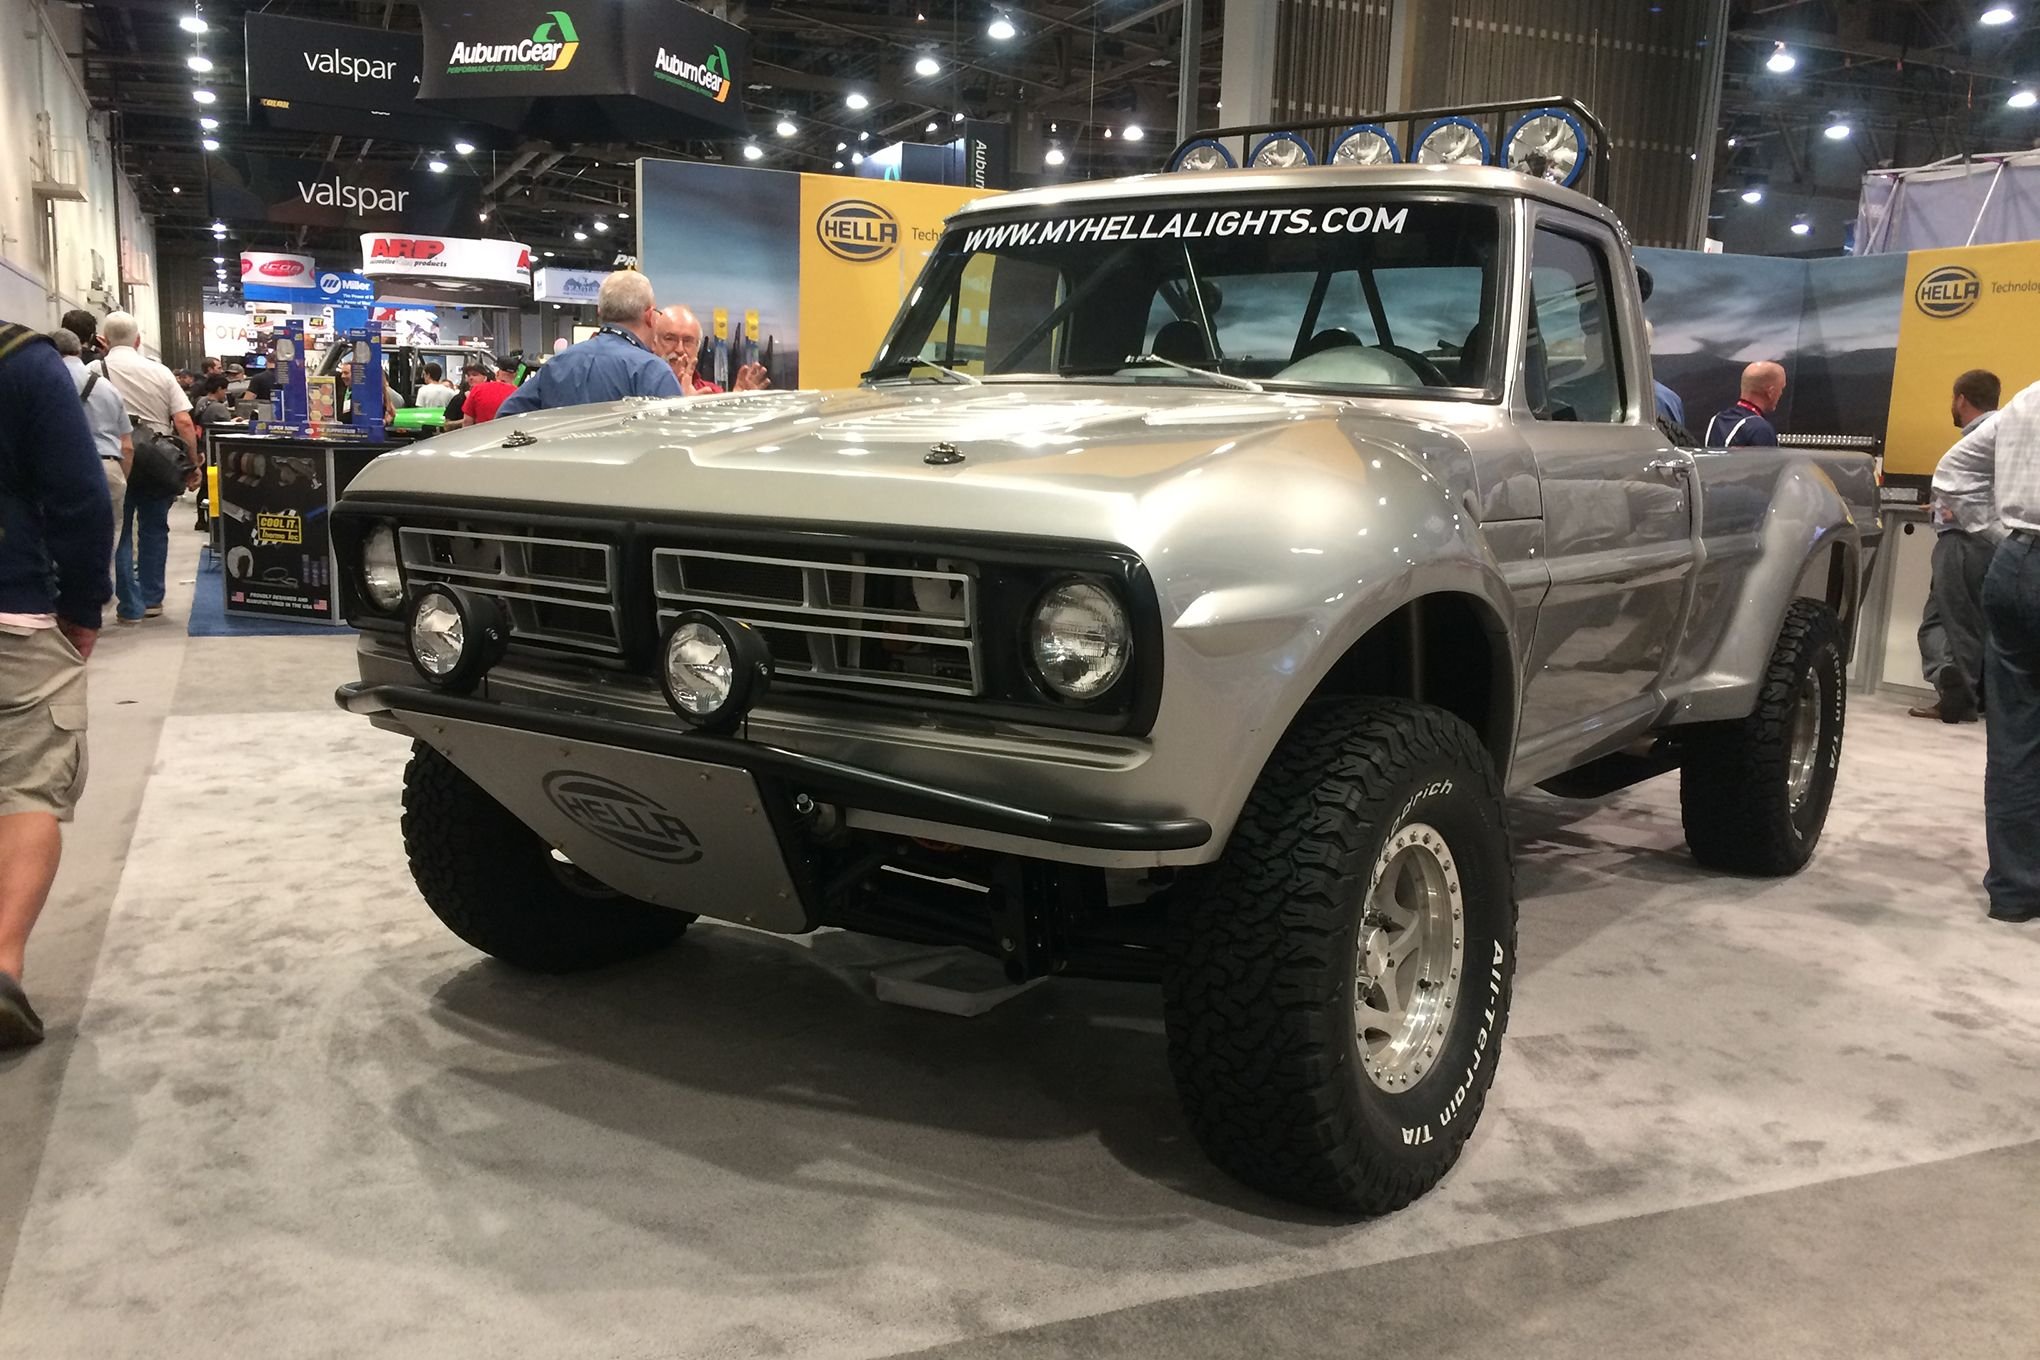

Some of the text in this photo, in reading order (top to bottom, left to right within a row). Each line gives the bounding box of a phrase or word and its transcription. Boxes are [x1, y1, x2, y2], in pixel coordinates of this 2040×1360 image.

[449, 39, 563, 65] AuburnGear
[303, 48, 397, 83] valspar
[655, 47, 723, 92] AuburnGear
[298, 176, 410, 216] valspar
[824, 220, 942, 244] HELLA Tech
[963, 207, 1409, 253] WWW.MYHELLALIGHTS.COM
[371, 238, 445, 259] ARP
[414, 260, 447, 268] products
[342, 279, 371, 290] Miller
[1921, 281, 1980, 300] HELLA
[260, 517, 296, 529] COOL IT
[557, 793, 702, 847] HELLA
[1439, 939, 1504, 1127] All-Terrain
[1401, 1124, 1434, 1146] T/A
